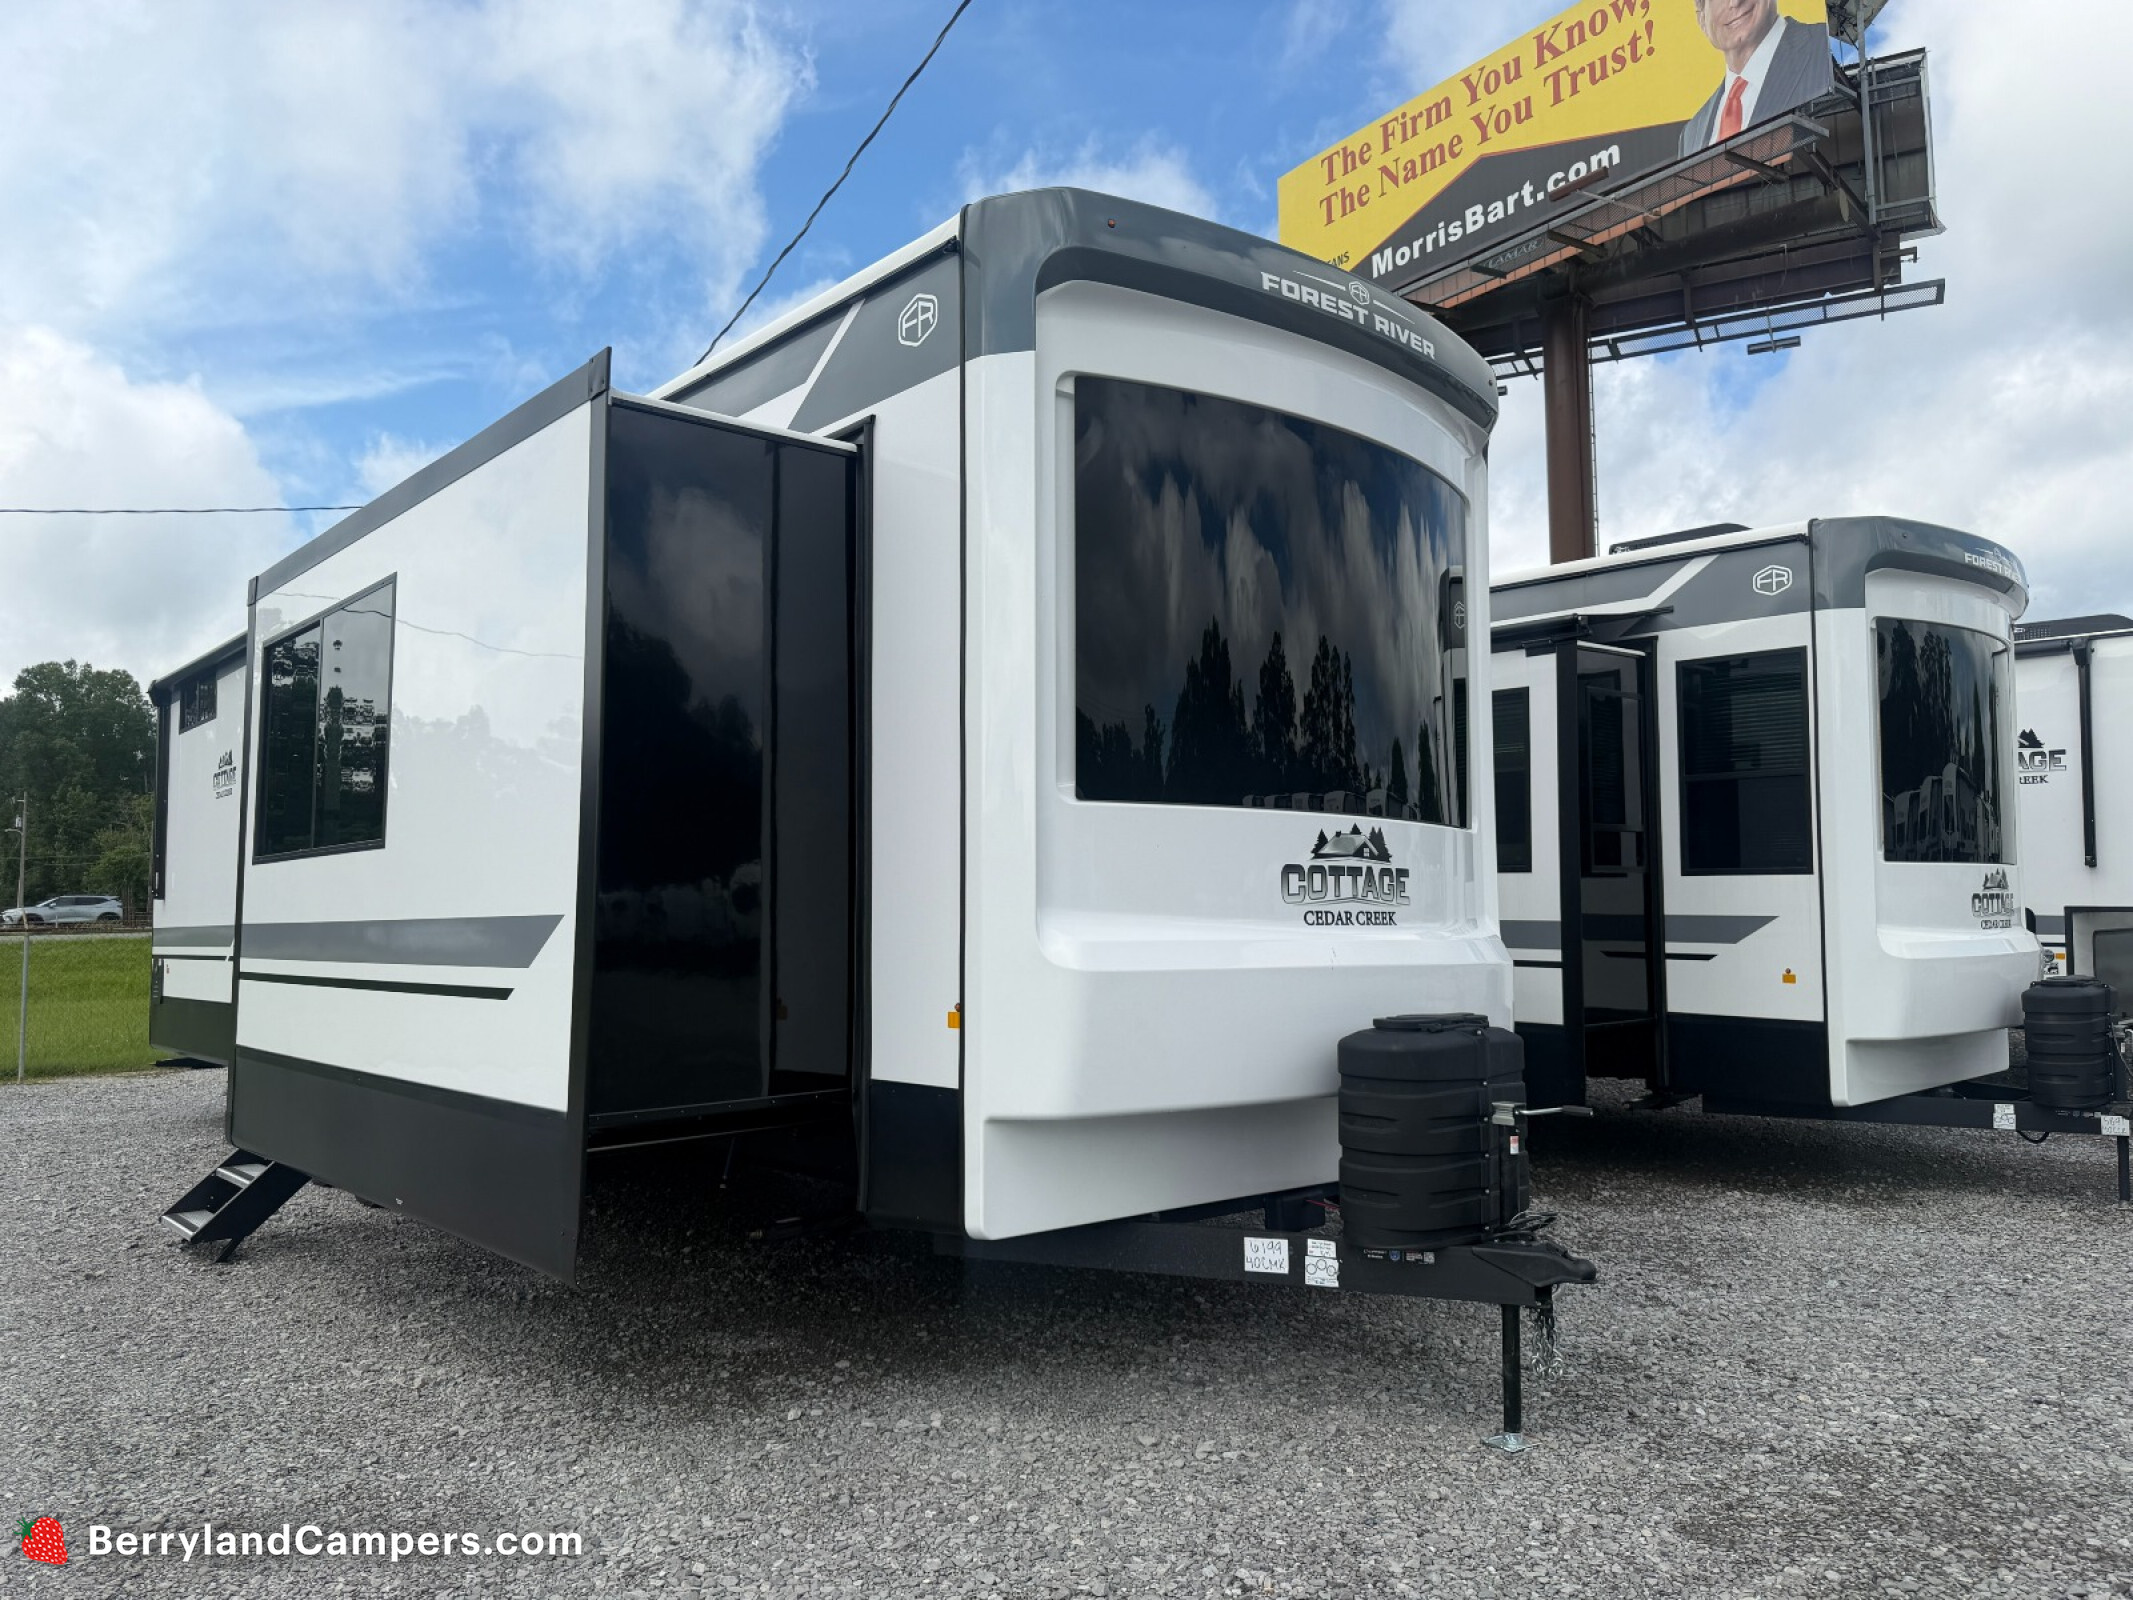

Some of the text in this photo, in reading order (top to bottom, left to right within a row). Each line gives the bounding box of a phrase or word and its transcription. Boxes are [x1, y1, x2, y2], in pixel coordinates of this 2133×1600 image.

[1320, 19, 1655, 227] The Name You Trust!
[1321, 0, 1651, 186] The Firm You Know,
[1372, 144, 1621, 279] MorrisBart.com
[1261, 271, 1436, 360] FOREST RIVER
[1281, 864, 1410, 905] COTTAGE
[1304, 910, 1397, 925] CEDAR CREEK
